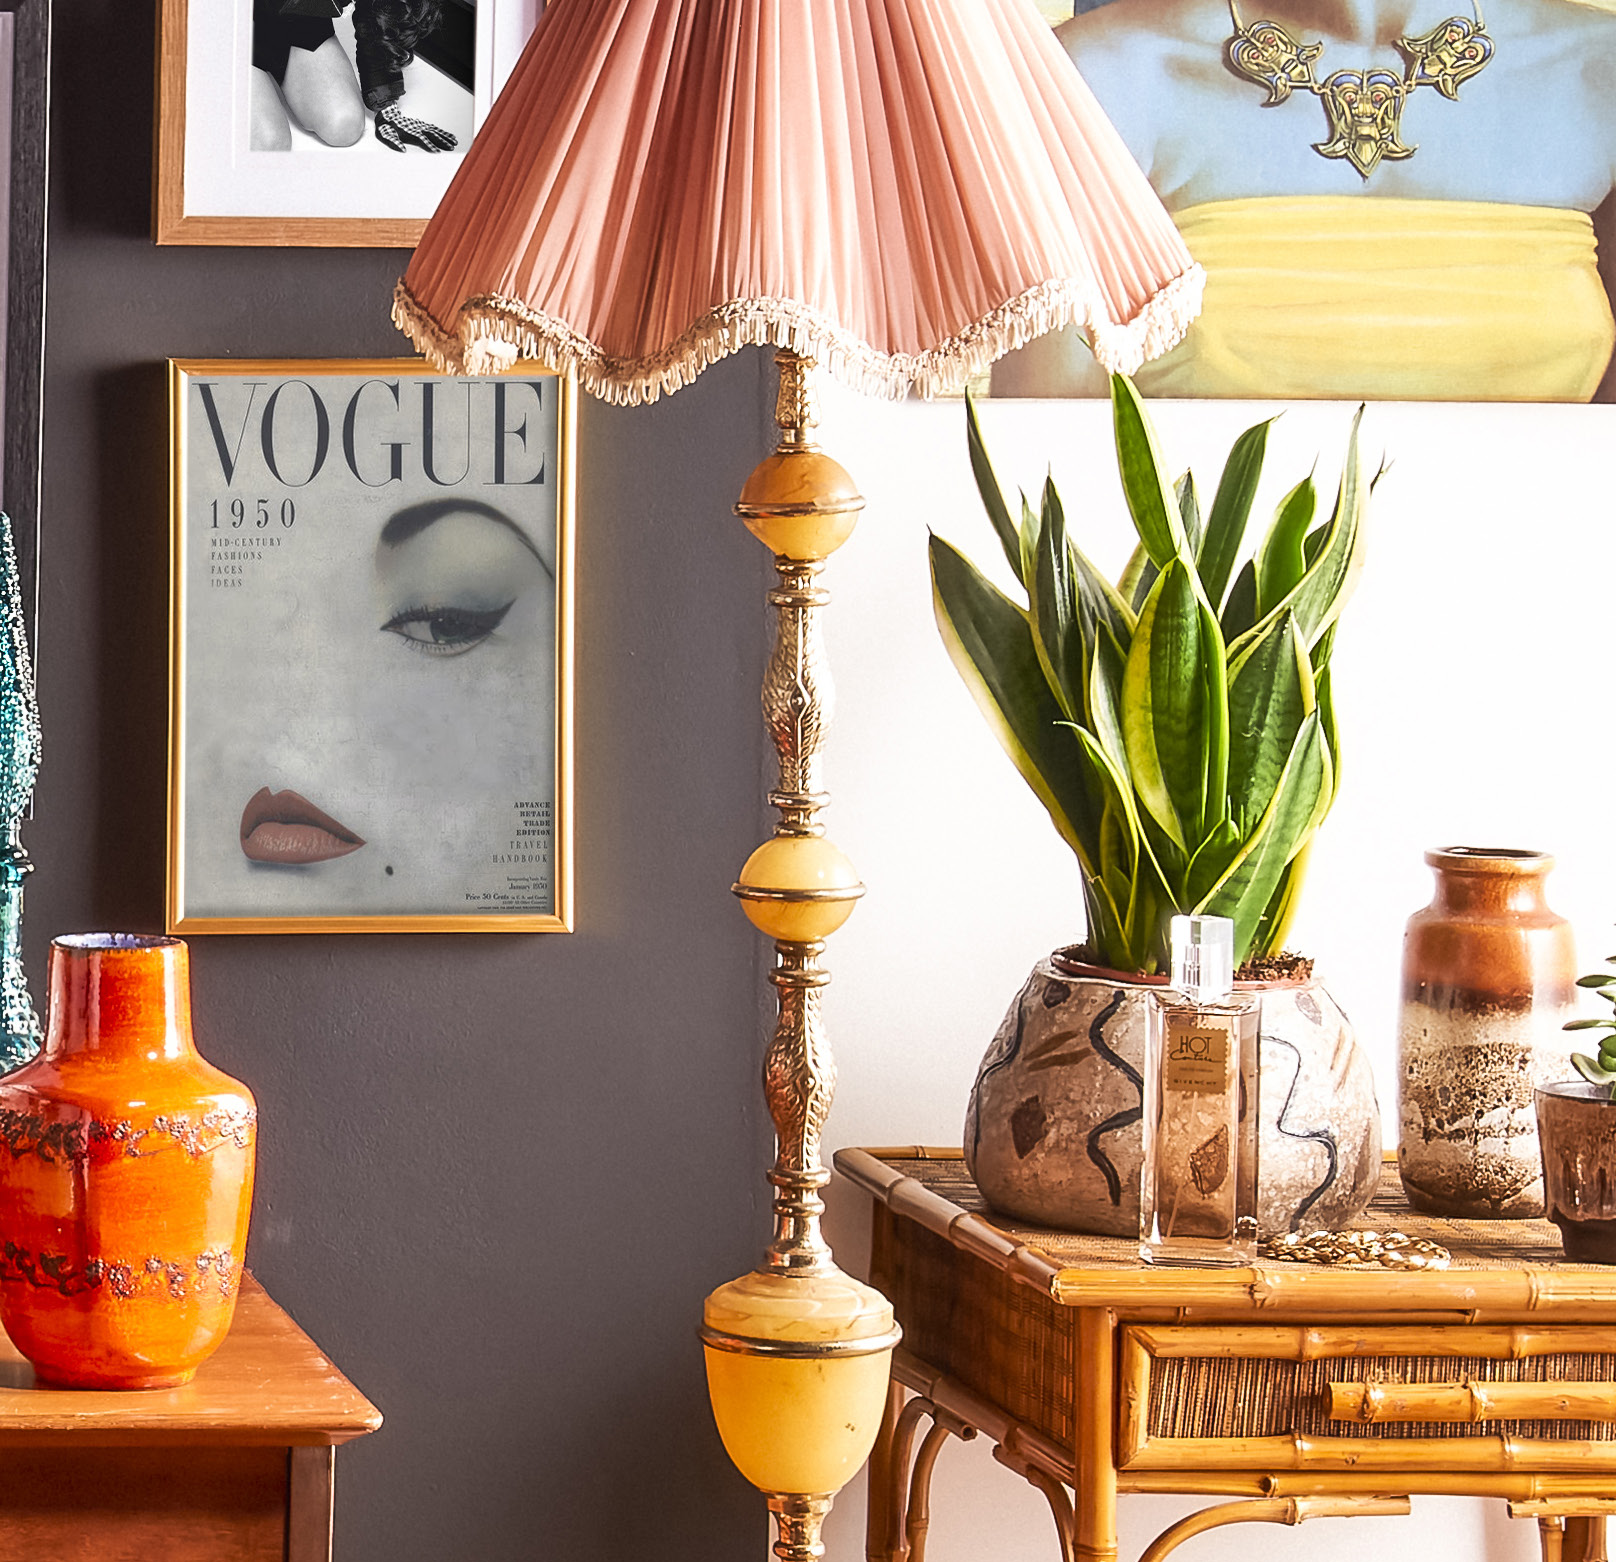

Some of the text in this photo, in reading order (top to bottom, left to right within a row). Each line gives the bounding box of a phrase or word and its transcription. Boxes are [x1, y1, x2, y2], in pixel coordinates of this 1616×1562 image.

[192, 379, 546, 488] VOGUE
[210, 498, 296, 529] 1950
[211, 537, 282, 547] MID-CENTURY
[211, 551, 263, 561] FASHIONS
[211, 565, 244, 574] FACES
[211, 578, 243, 588] IDEAS
[514, 801, 551, 809] ADVANCE
[510, 840, 548, 850] TRAVEL
[492, 854, 548, 863] HANDBOOK
[1180, 1035, 1212, 1054] HOT
